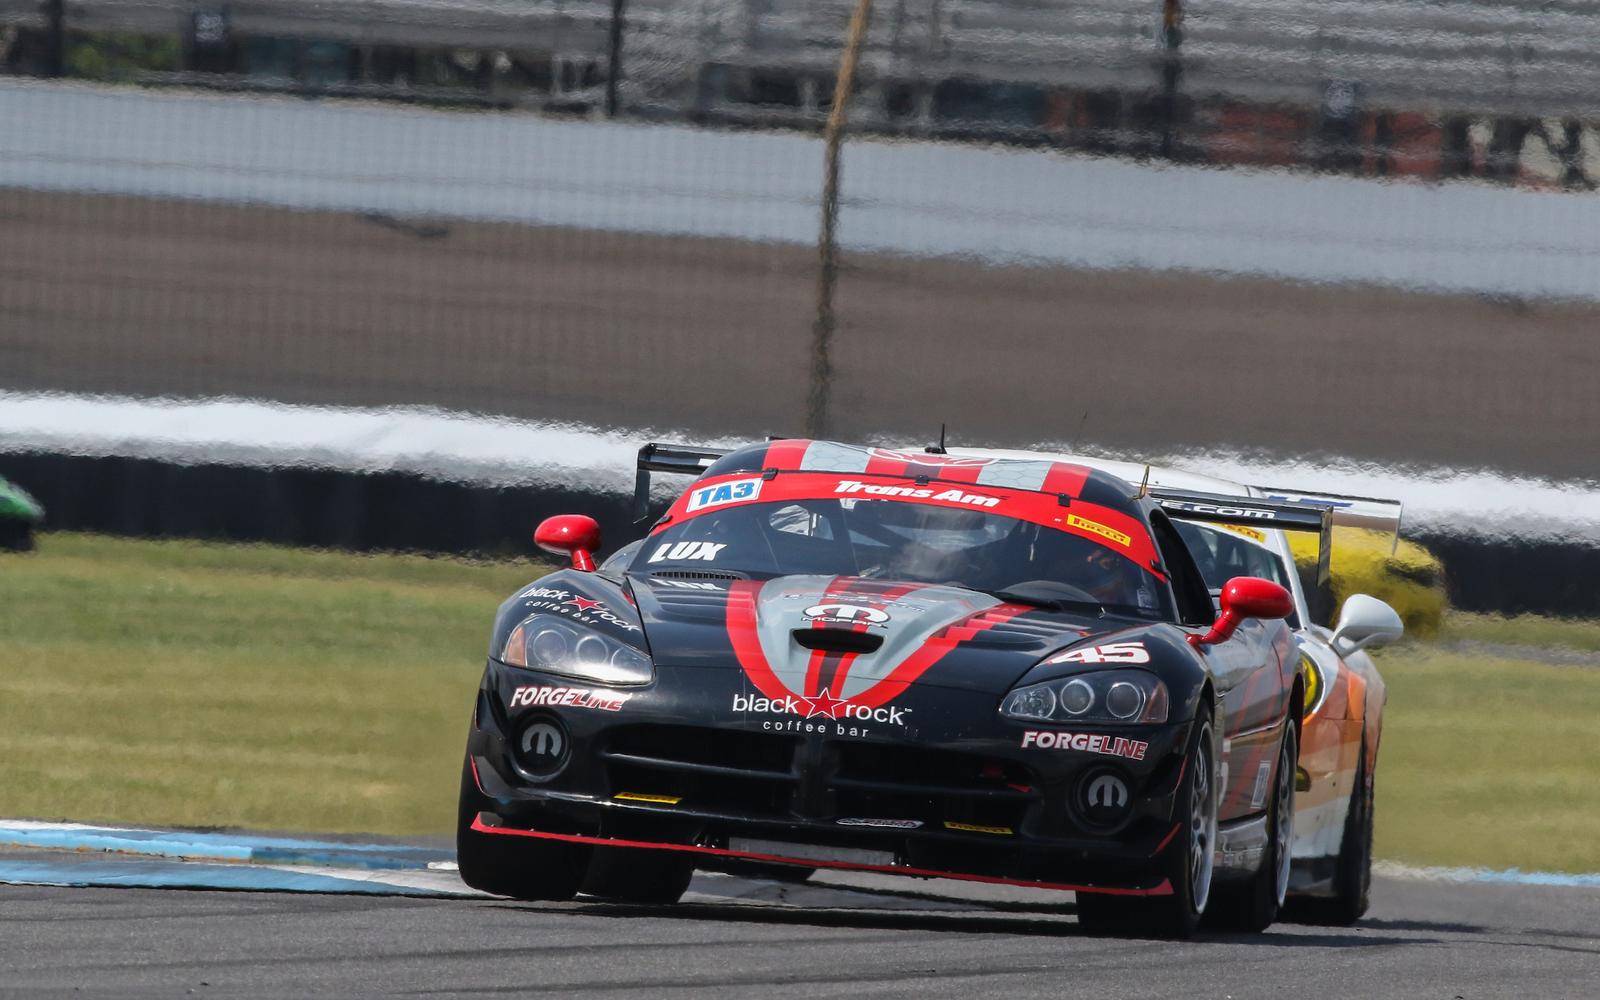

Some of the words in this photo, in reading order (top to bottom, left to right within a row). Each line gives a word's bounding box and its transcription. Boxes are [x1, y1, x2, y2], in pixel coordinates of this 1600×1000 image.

[698, 481, 755, 507] TA3
[834, 480, 933, 498] Trans
[931, 489, 1000, 507] Am
[647, 541, 728, 564] LUX
[519, 587, 570, 600] black
[591, 608, 641, 631] rock
[525, 600, 569, 613] coffee
[573, 613, 599, 624] bar
[1046, 642, 1150, 665] 45
[510, 686, 633, 711] FORGELINE
[732, 693, 800, 714] black
[762, 720, 826, 733] coffee
[837, 724, 869, 738] bar
[1021, 730, 1149, 761] FORGELINE
